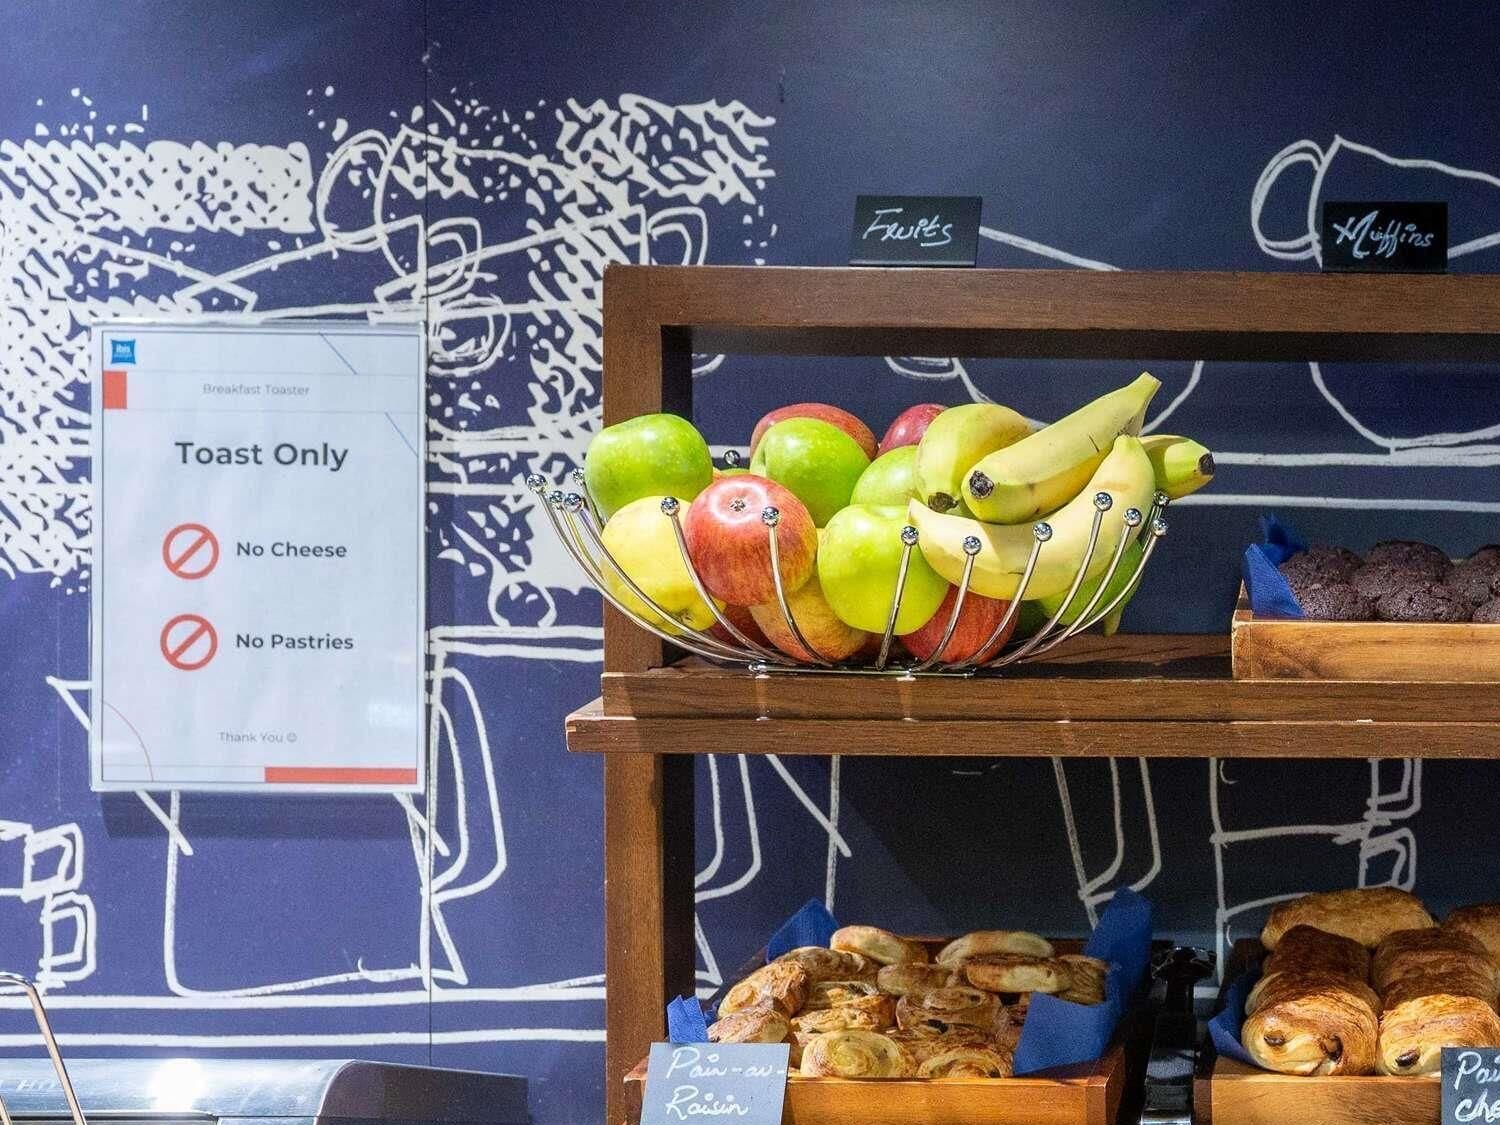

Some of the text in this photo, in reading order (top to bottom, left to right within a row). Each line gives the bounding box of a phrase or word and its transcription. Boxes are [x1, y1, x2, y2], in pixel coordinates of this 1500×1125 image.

[862, 208, 952, 246] Fruits
[1333, 210, 1434, 259] Muffins
[203, 383, 310, 396] Breakfast Toaster
[175, 442, 349, 472] Toast Only
[236, 541, 348, 558] No Cheese
[236, 633, 355, 650] No Pastries
[219, 731, 284, 743] Thank You
[665, 1084, 751, 1121] Raisin
